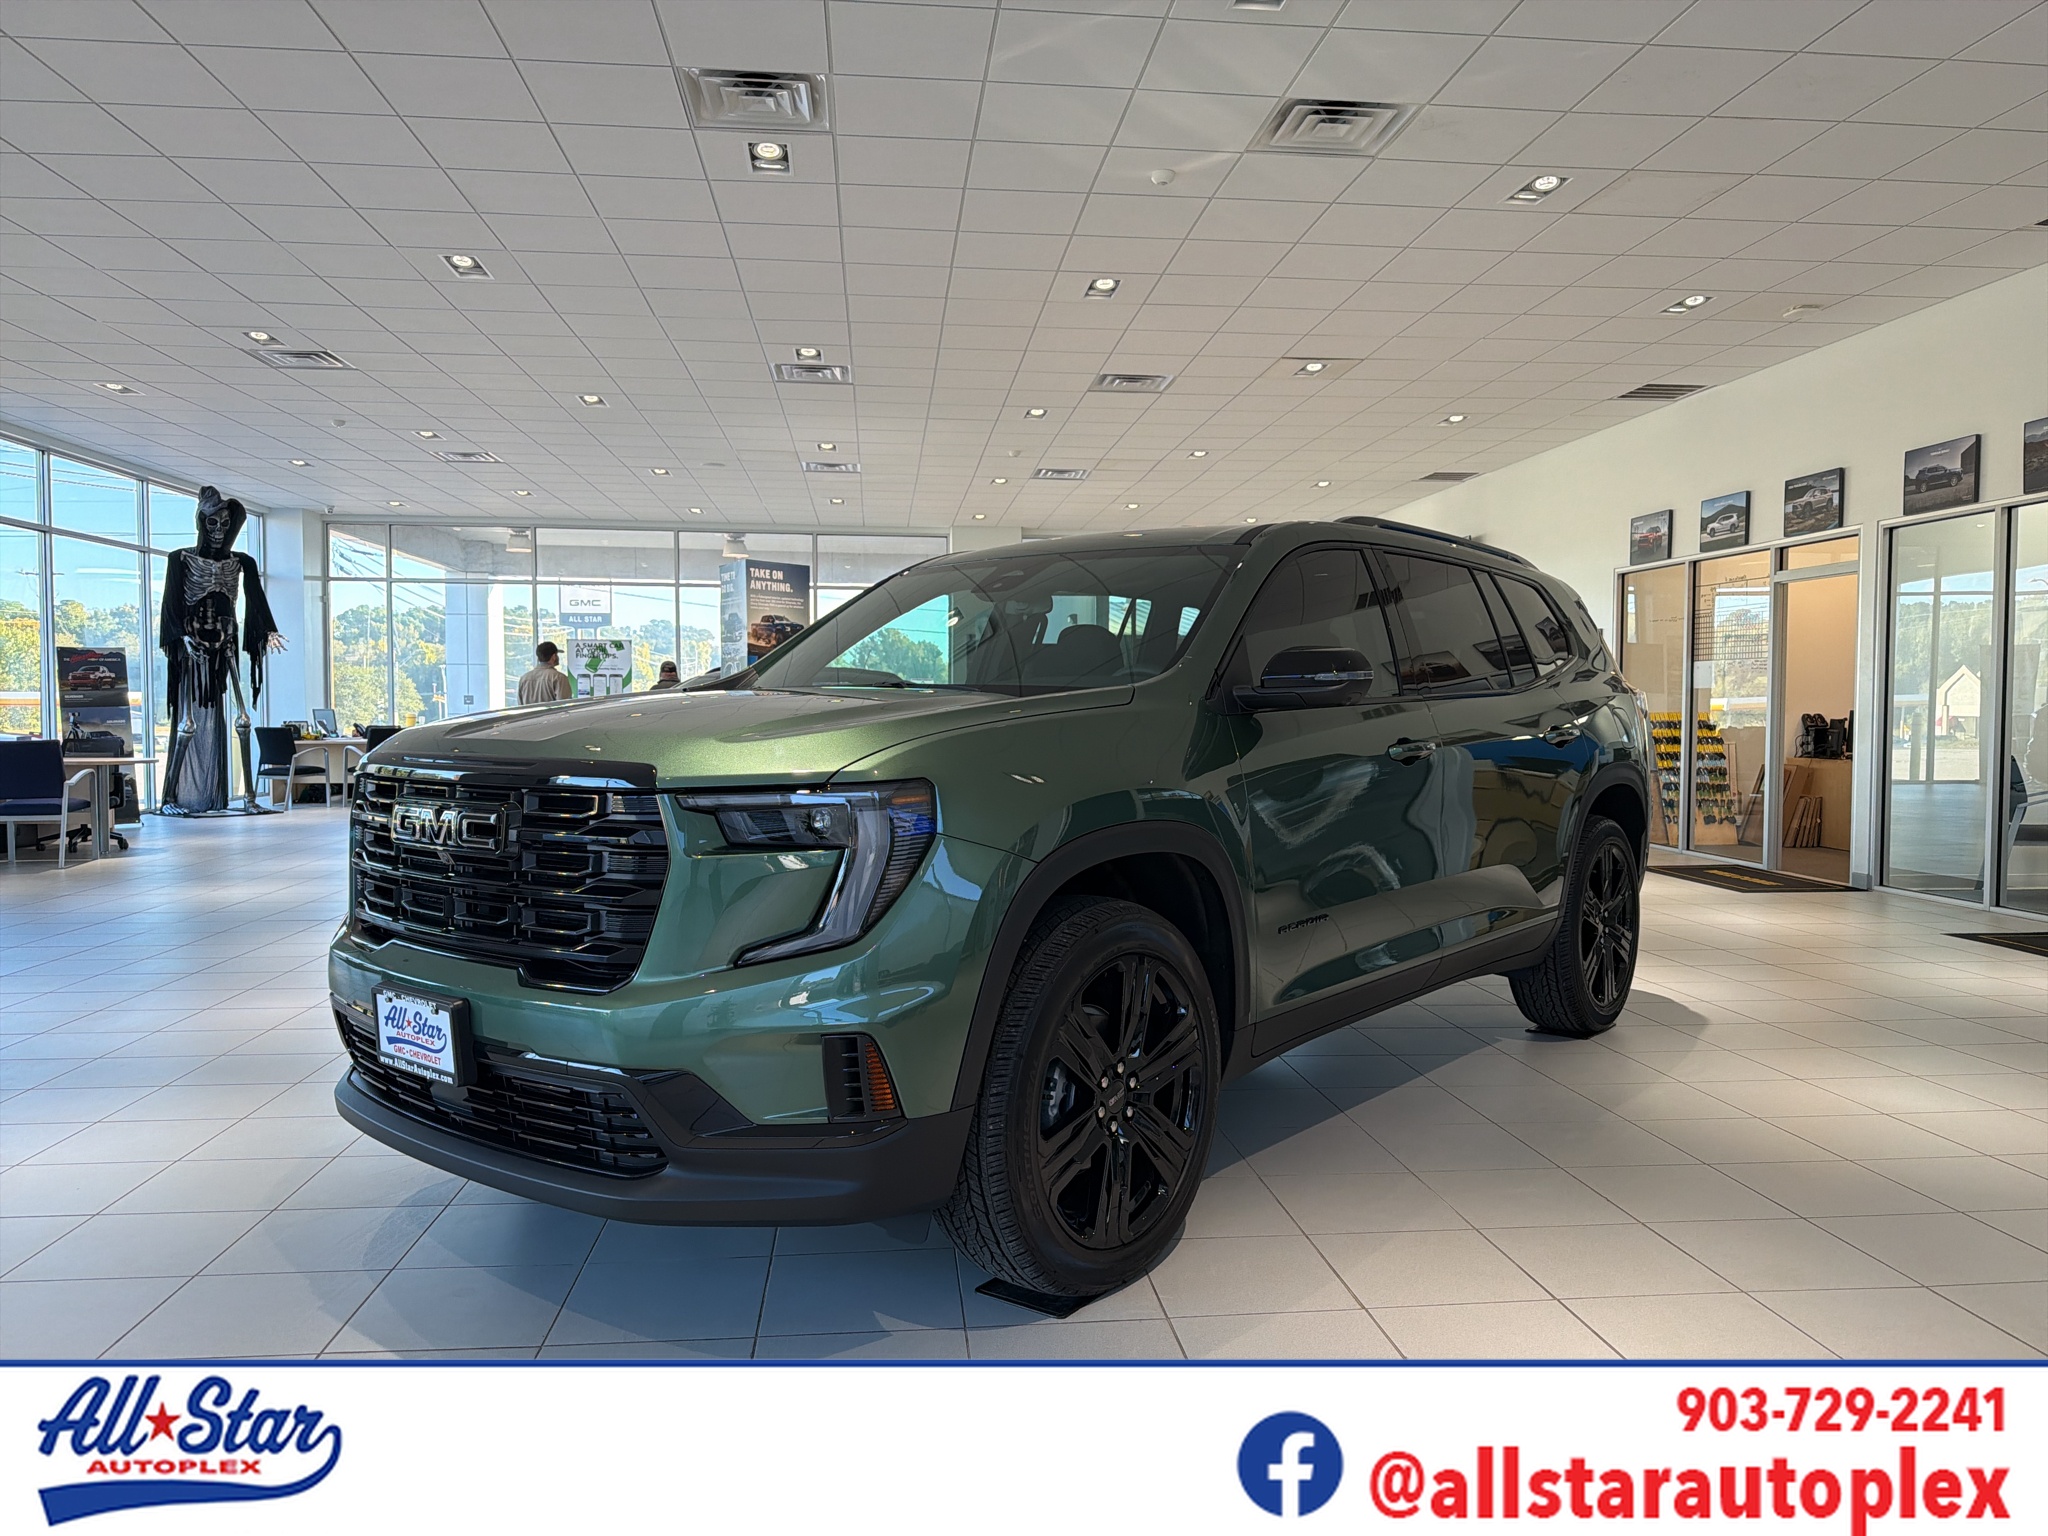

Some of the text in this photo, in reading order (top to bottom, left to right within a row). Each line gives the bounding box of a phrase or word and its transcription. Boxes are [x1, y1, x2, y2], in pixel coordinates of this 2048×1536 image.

[749, 567, 784, 580] TAKE ON
[749, 580, 794, 593] ANYTHING.
[569, 599, 602, 607] GMC
[568, 615, 603, 623] ALL STAR
[392, 805, 497, 850] GMC
[383, 990, 437, 1009] GMC CHEVROLET
[384, 1005, 445, 1042] All Star
[396, 1030, 436, 1047] AUTOPLEX
[380, 1056, 454, 1085] www.AllStarAutoplex.com
